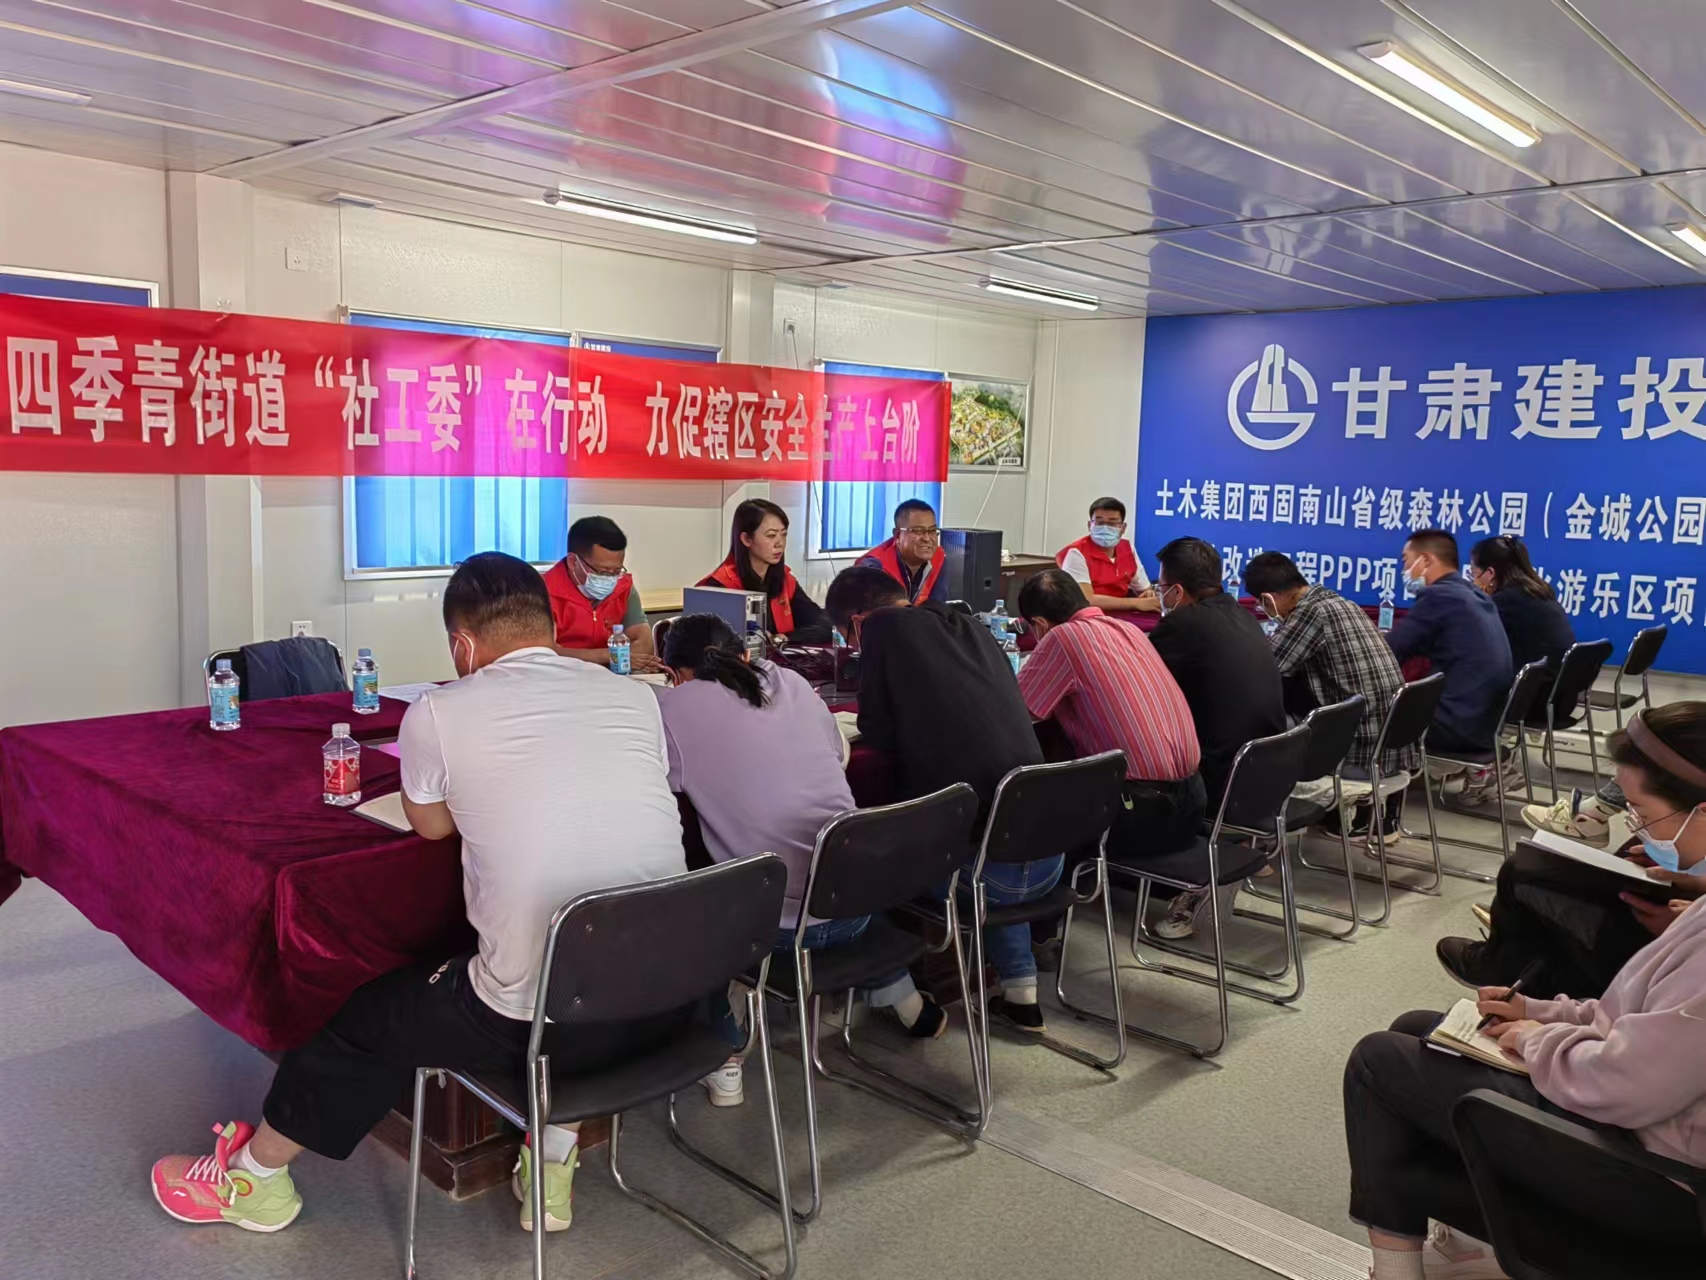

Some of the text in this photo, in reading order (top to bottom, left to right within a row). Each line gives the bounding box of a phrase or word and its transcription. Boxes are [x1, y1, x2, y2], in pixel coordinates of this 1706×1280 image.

[645, 380, 921, 464] 力促辖区安全生产上台阶
[1332, 356, 1706, 441] 甘肃建投
